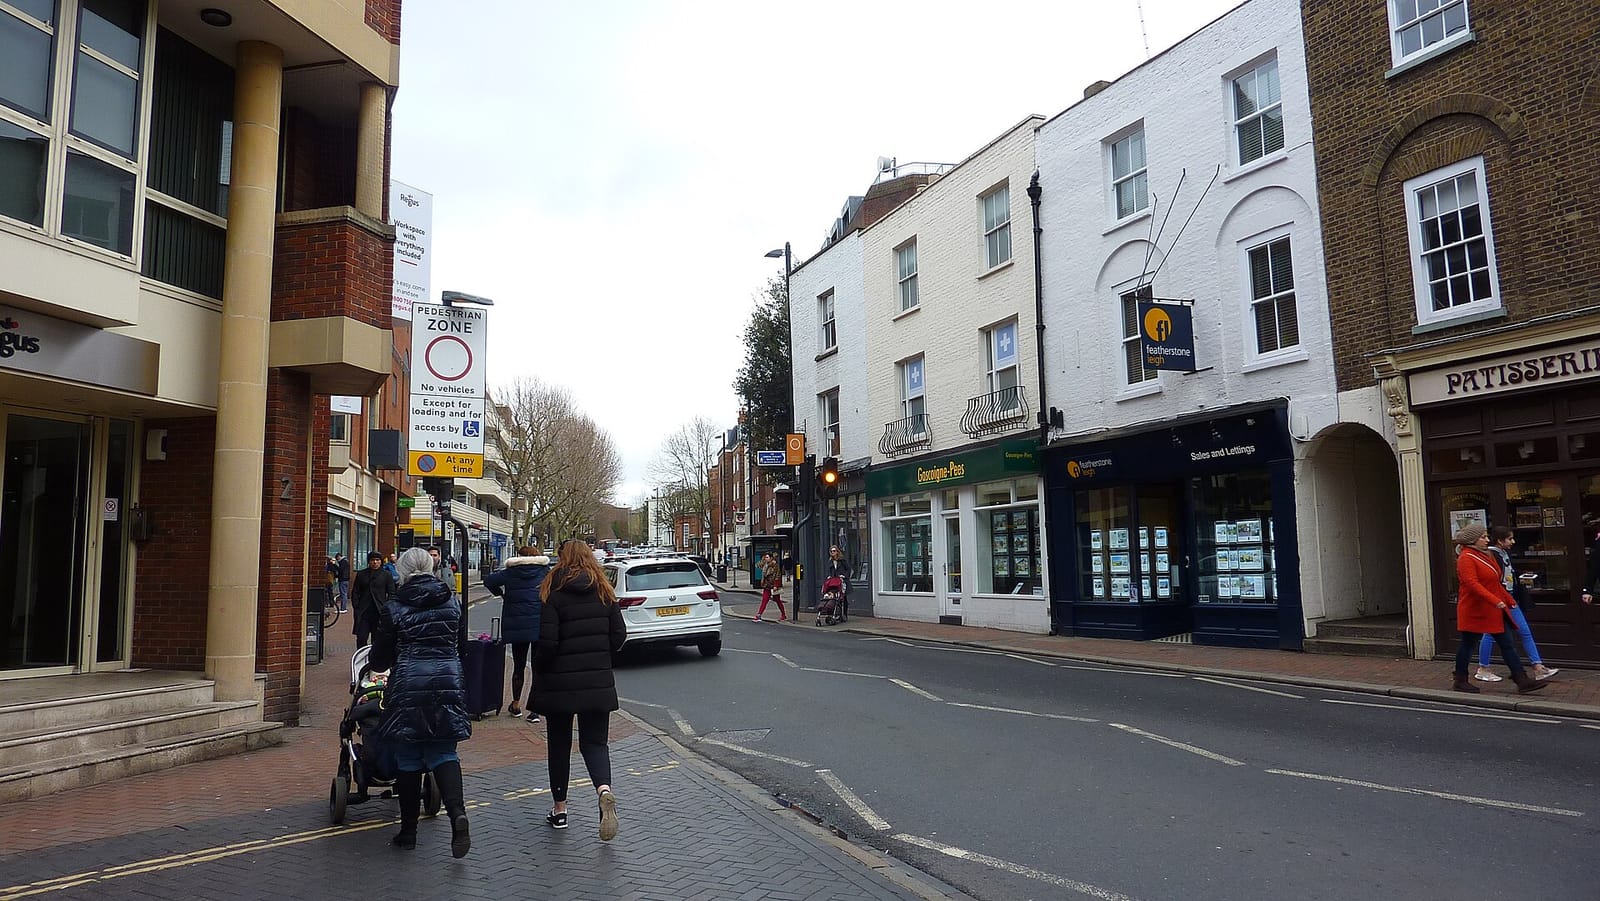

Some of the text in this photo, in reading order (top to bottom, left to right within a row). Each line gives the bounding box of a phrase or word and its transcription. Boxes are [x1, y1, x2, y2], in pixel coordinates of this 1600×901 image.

[400, 193, 419, 207] Regus
[394, 219, 425, 235] Workspace
[403, 233, 417, 241] with
[396, 240, 425, 255] verything
[397, 248, 421, 260] included
[418, 306, 482, 320] PEDESTRIAN
[427, 319, 473, 334] ZONE
[0, 332, 40, 358] gus
[1146, 343, 1191, 357] featherstone
[1147, 354, 1165, 367] leigh
[421, 383, 475, 394] No vehicles
[423, 398, 471, 409] Except for
[412, 408, 482, 419] loading and for
[414, 424, 460, 434] access by
[426, 440, 468, 450] to toilets
[1190, 445, 1256, 461] Sales and Lettings
[446, 456, 475, 466] At any
[453, 466, 473, 474] time
[917, 461, 965, 483] Gascoigne-Pees
[280, 477, 296, 500] 2
